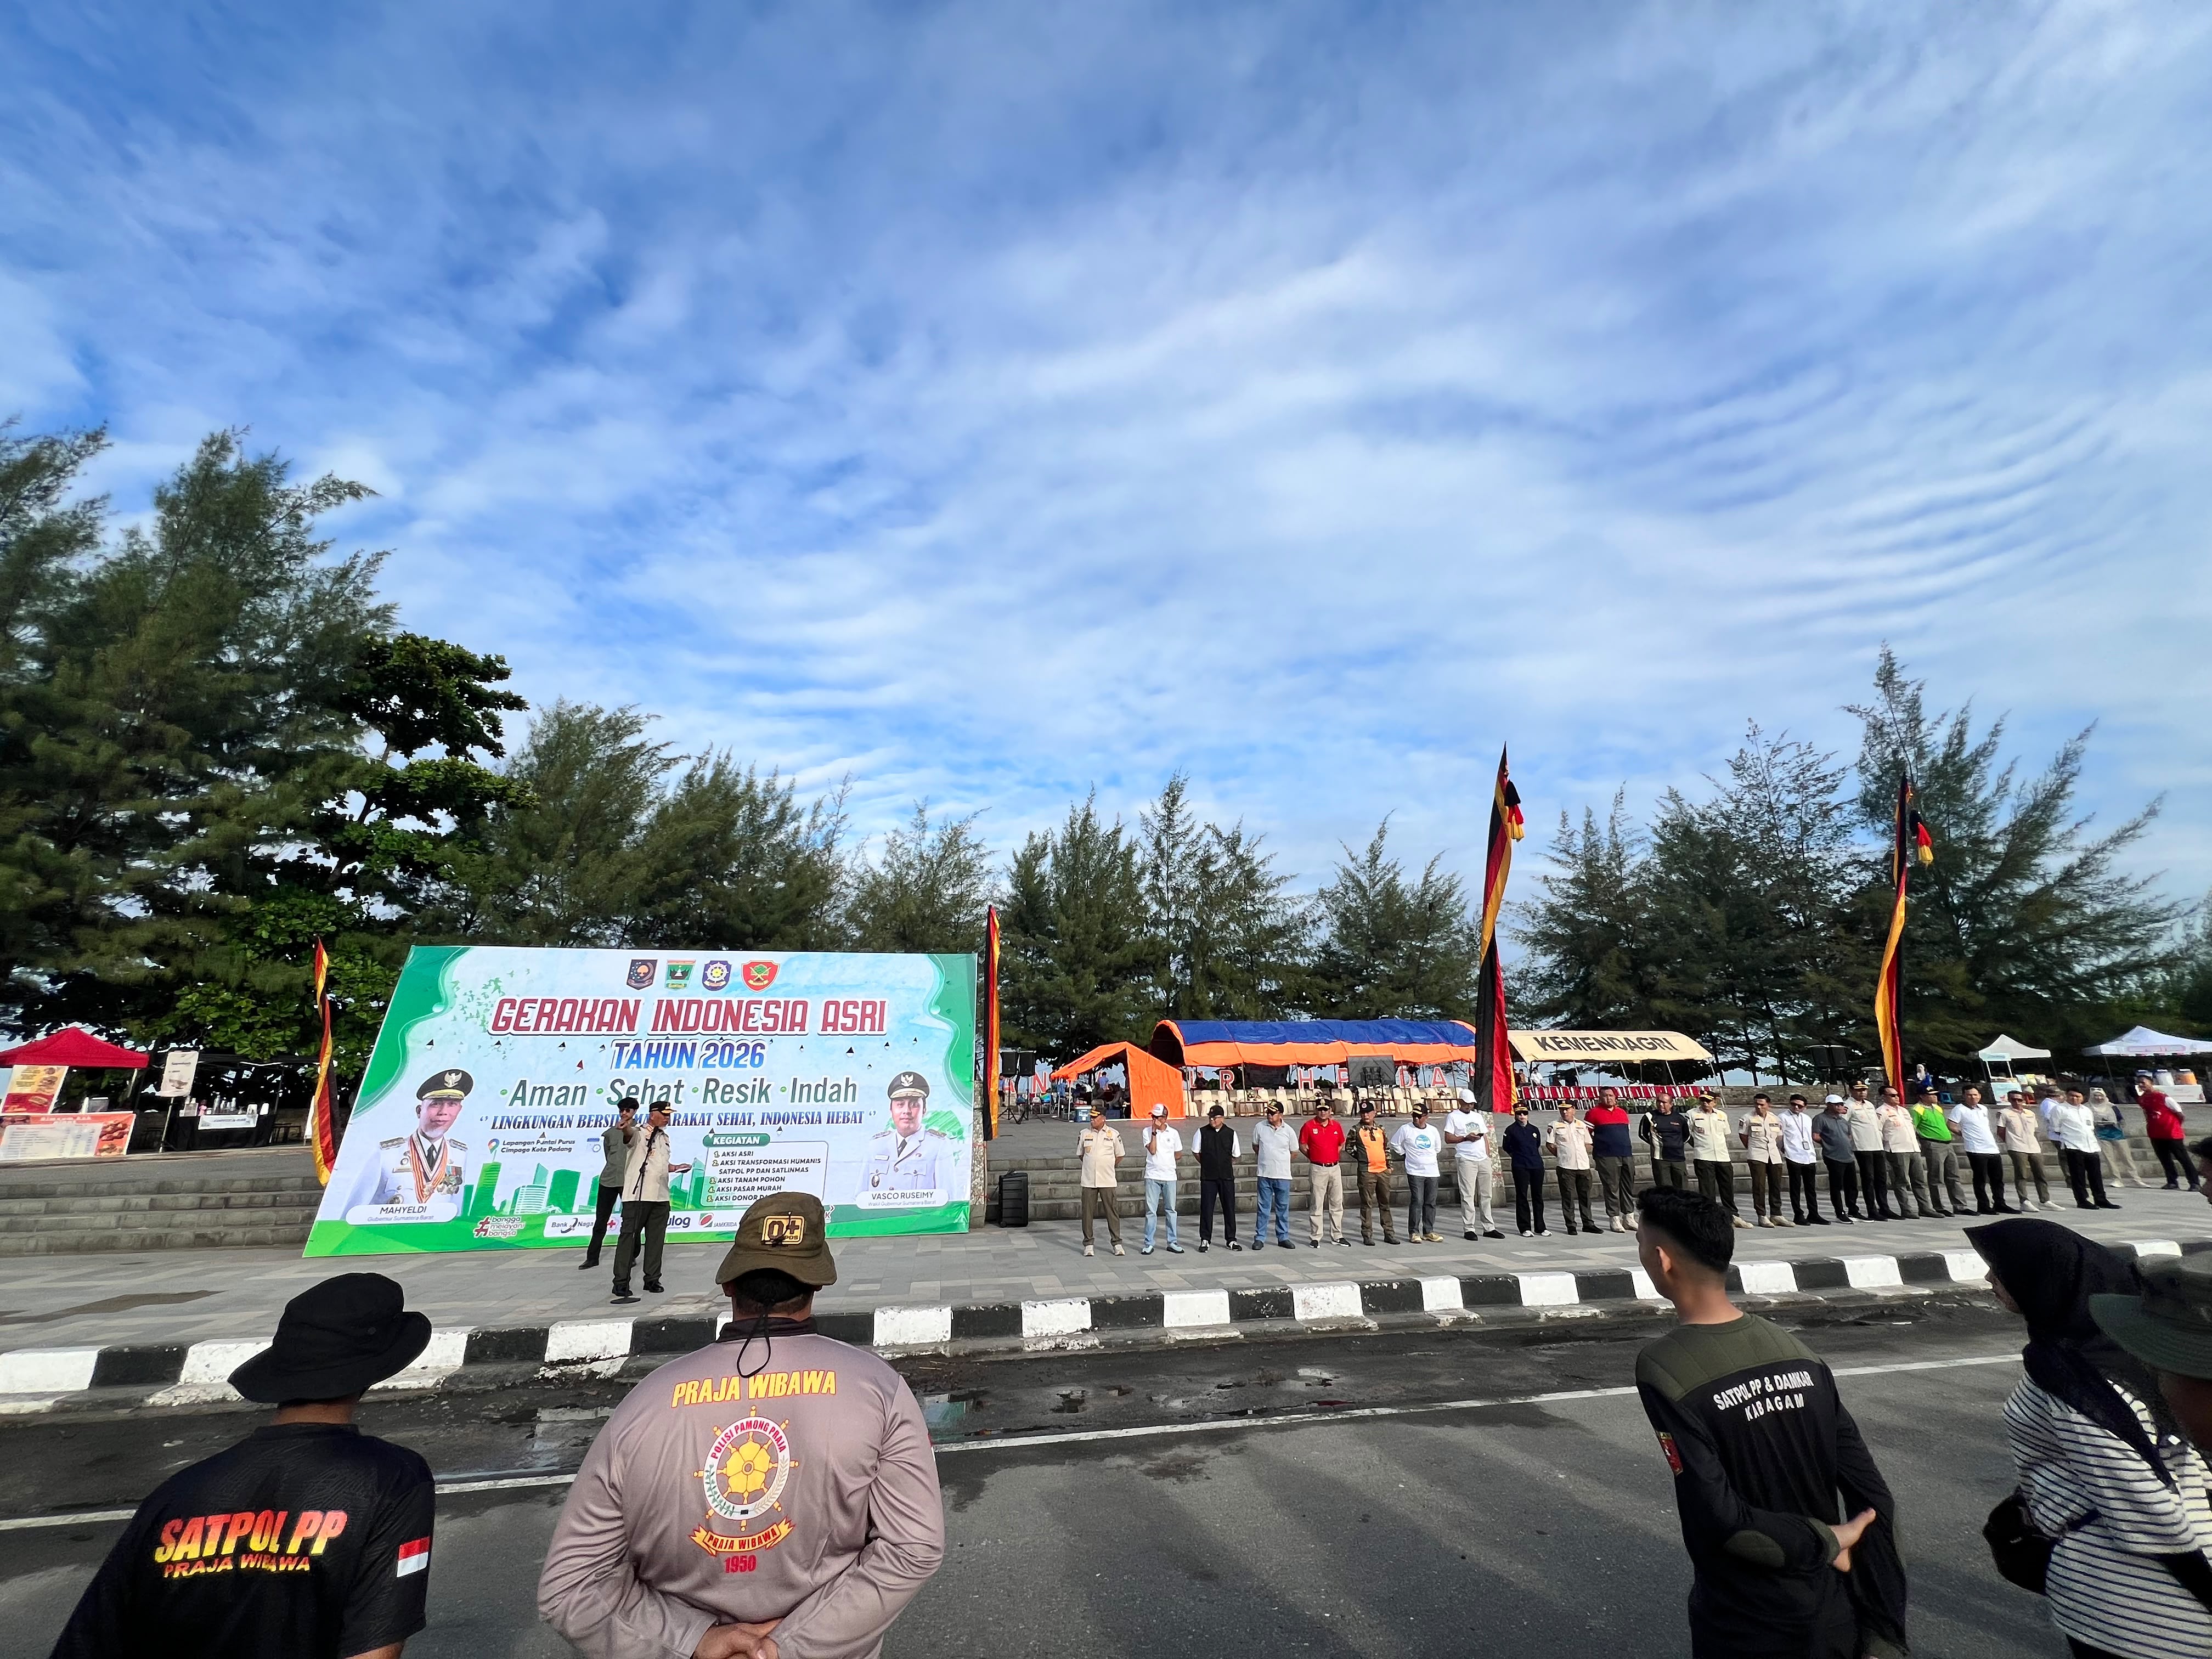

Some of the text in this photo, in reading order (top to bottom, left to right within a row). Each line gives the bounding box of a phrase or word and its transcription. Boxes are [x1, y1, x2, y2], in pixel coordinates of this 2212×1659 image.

[492, 998, 887, 1032] GERAKAN INDONESIA ASRI
[614, 1042, 766, 1069] TAHUN 2026
[1533, 1036, 1680, 1052] KEMENDAGRI
[509, 1077, 857, 1107] Aman Sehat Resik Indah
[490, 1115, 572, 1130] LINGKUNGAN
[716, 1112, 755, 1127] SEHAT,
[760, 1111, 822, 1126] INDONESIA
[826, 1111, 865, 1124] HEBAT
[713, 1136, 760, 1145] KEGIATAN
[379, 1206, 427, 1215] MAHYELDI
[667, 1215, 691, 1228] ulog
[671, 1369, 837, 1408] PRAJA WIBAWA
[1713, 1370, 1814, 1410] SATPOL PP & DAMKAR
[1744, 1393, 1804, 1421] KAB AGAM
[710, 1420, 786, 1459] POLISI PAMONG PRAJA
[154, 1509, 348, 1563] SATPOL PP
[707, 1527, 777, 1550] PRAJA WIBAWA
[163, 1555, 234, 1578] PRAJA
[724, 1554, 757, 1573] 1950
